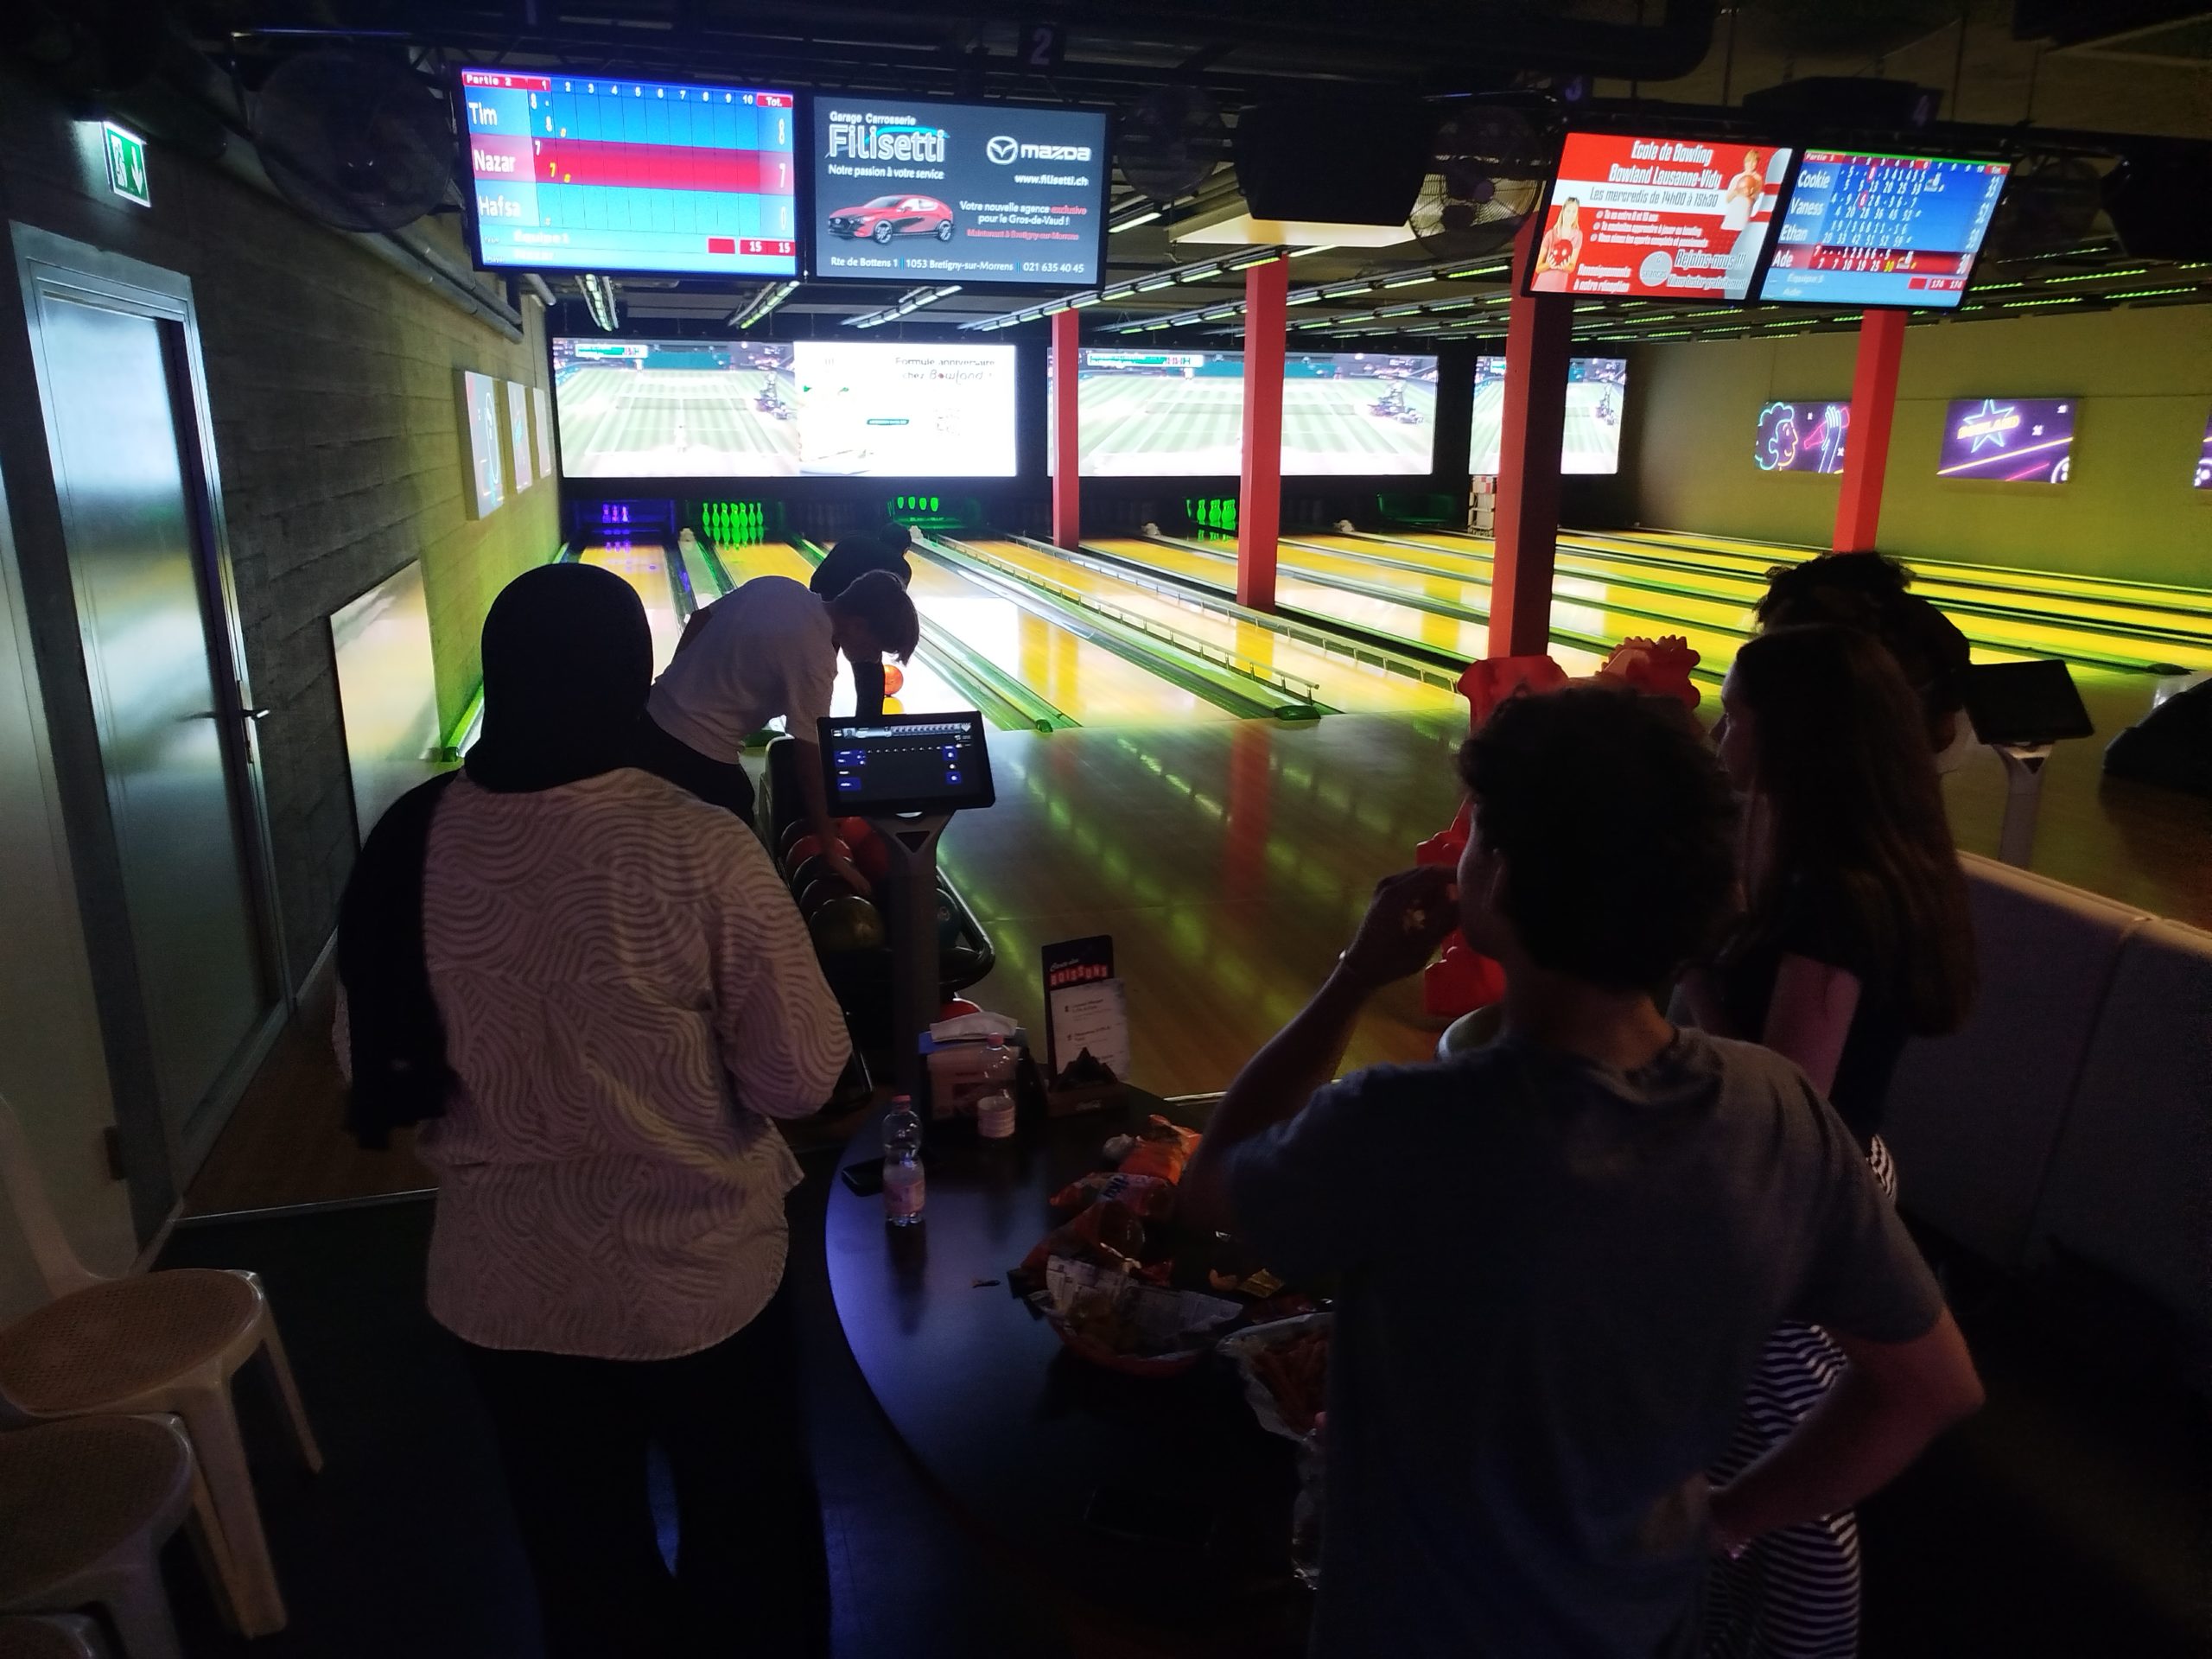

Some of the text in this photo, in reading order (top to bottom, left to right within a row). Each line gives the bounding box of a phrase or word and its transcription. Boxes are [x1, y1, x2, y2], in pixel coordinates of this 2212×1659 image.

[1030, 28, 1053, 65] 2
[467, 74, 512, 86] Partie 2
[531, 92, 537, 110] 8
[541, 79, 548, 91] 1
[565, 81, 571, 92] 2
[588, 83, 594, 94] 3
[611, 85, 618, 95] 4
[680, 90, 686, 100] 7
[743, 94, 753, 105] 10
[766, 96, 783, 107] Tot.
[468, 101, 498, 126] Tim
[830, 111, 916, 126] Garage Carrosserie
[545, 116, 553, 132] 8
[779, 118, 785, 145] 8
[535, 140, 541, 156] 7
[829, 124, 945, 162] Filisetti
[474, 149, 517, 173] Nazar
[1659, 142, 1673, 162] de
[1673, 143, 1714, 167] Bowling
[550, 162, 556, 178] 7
[779, 162, 786, 188] 7
[828, 164, 945, 180] Notre passion à votre service
[1609, 162, 1723, 190] Bowland Lausanne-Vidy
[1797, 169, 1830, 189] Cookie
[1014, 175, 1089, 187] www.filisetti.ch
[479, 194, 522, 218] Hafsa
[1590, 187, 1605, 201] Les
[1605, 189, 1649, 204] mercredis
[1649, 190, 1660, 205] de
[1661, 191, 1687, 207] 14h00
[1687, 193, 1693, 207] à
[959, 200, 983, 211] Votre
[984, 202, 1020, 213] nouvelle
[1020, 205, 1051, 215] agence
[1789, 197, 1824, 216] Vaness
[781, 206, 786, 231] 0
[978, 214, 999, 225] pour
[999, 213, 1007, 224] le
[1008, 214, 1065, 226] Gros-de-Vaud
[1780, 223, 1808, 242] Ethan
[749, 241, 762, 252] 15
[779, 242, 791, 254] 15
[830, 257, 845, 266] Rte
[847, 257, 858, 267] de
[860, 257, 892, 268] Bottens
[906, 259, 928, 269] 1053
[1023, 262, 1084, 273] 021 635 40 45
[1771, 249, 1794, 268] Ade
[895, 356, 935, 366] Formule
